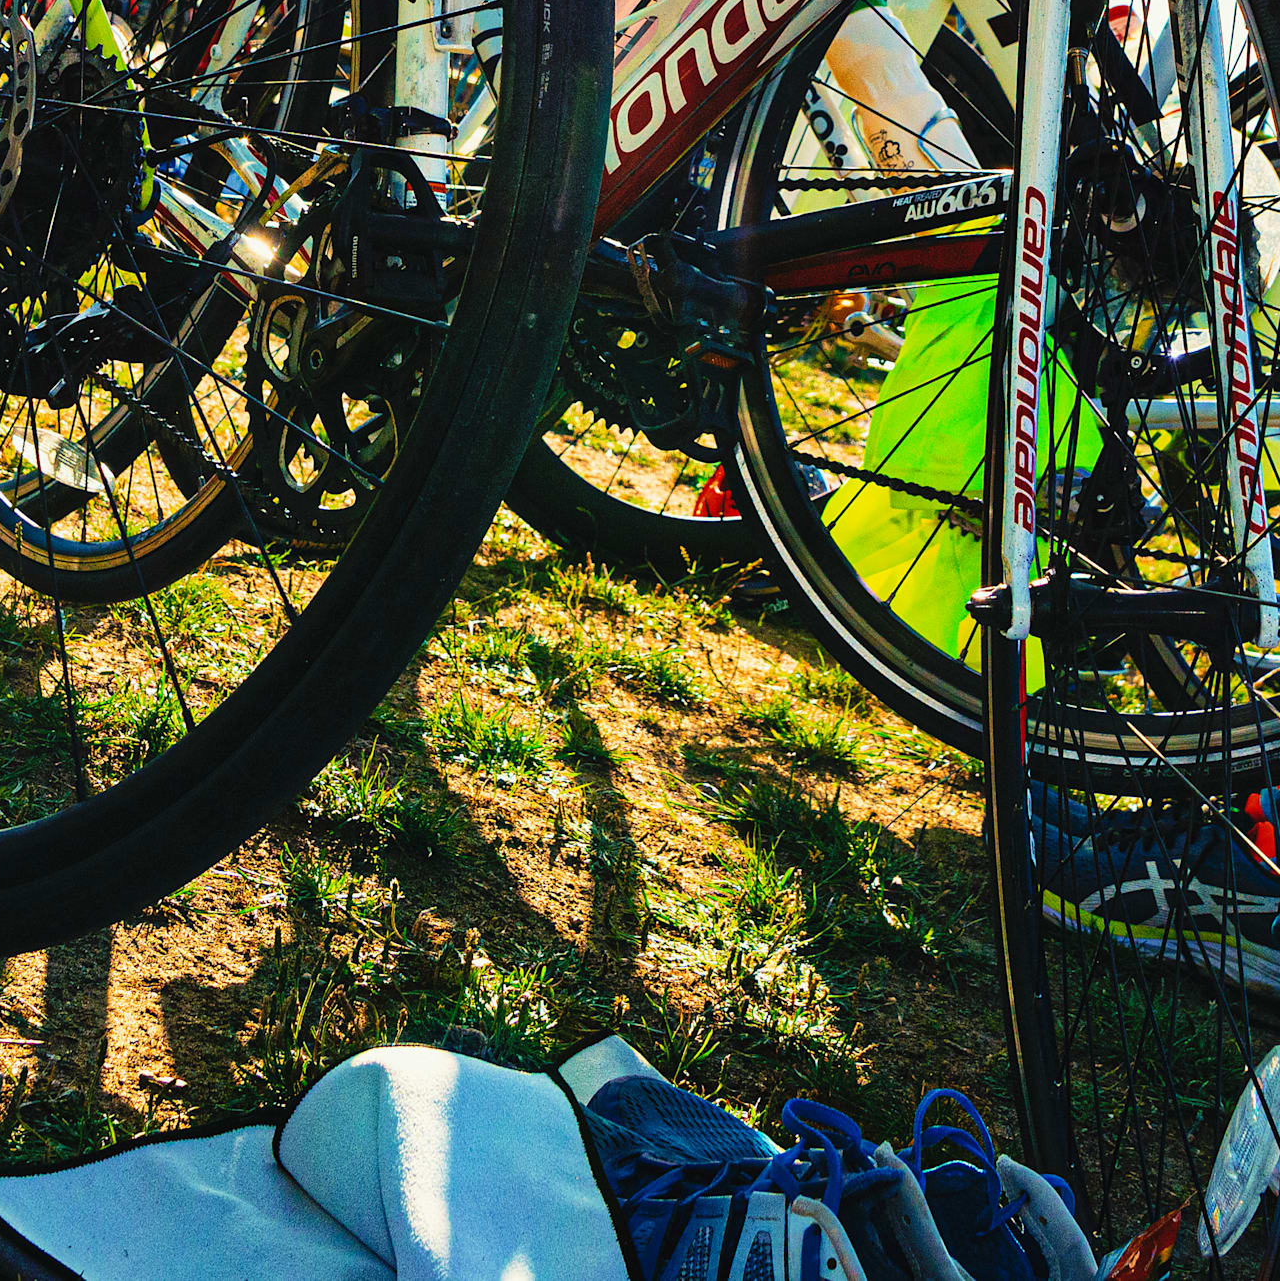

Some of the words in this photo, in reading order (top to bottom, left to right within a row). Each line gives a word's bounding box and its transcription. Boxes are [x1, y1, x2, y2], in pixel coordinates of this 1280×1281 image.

[351, 235, 359, 279] SHIMANO
[892, 196, 913, 208] HEAT
[1013, 185, 1048, 534] cannondale
[1212, 190, 1267, 536] cannondale
